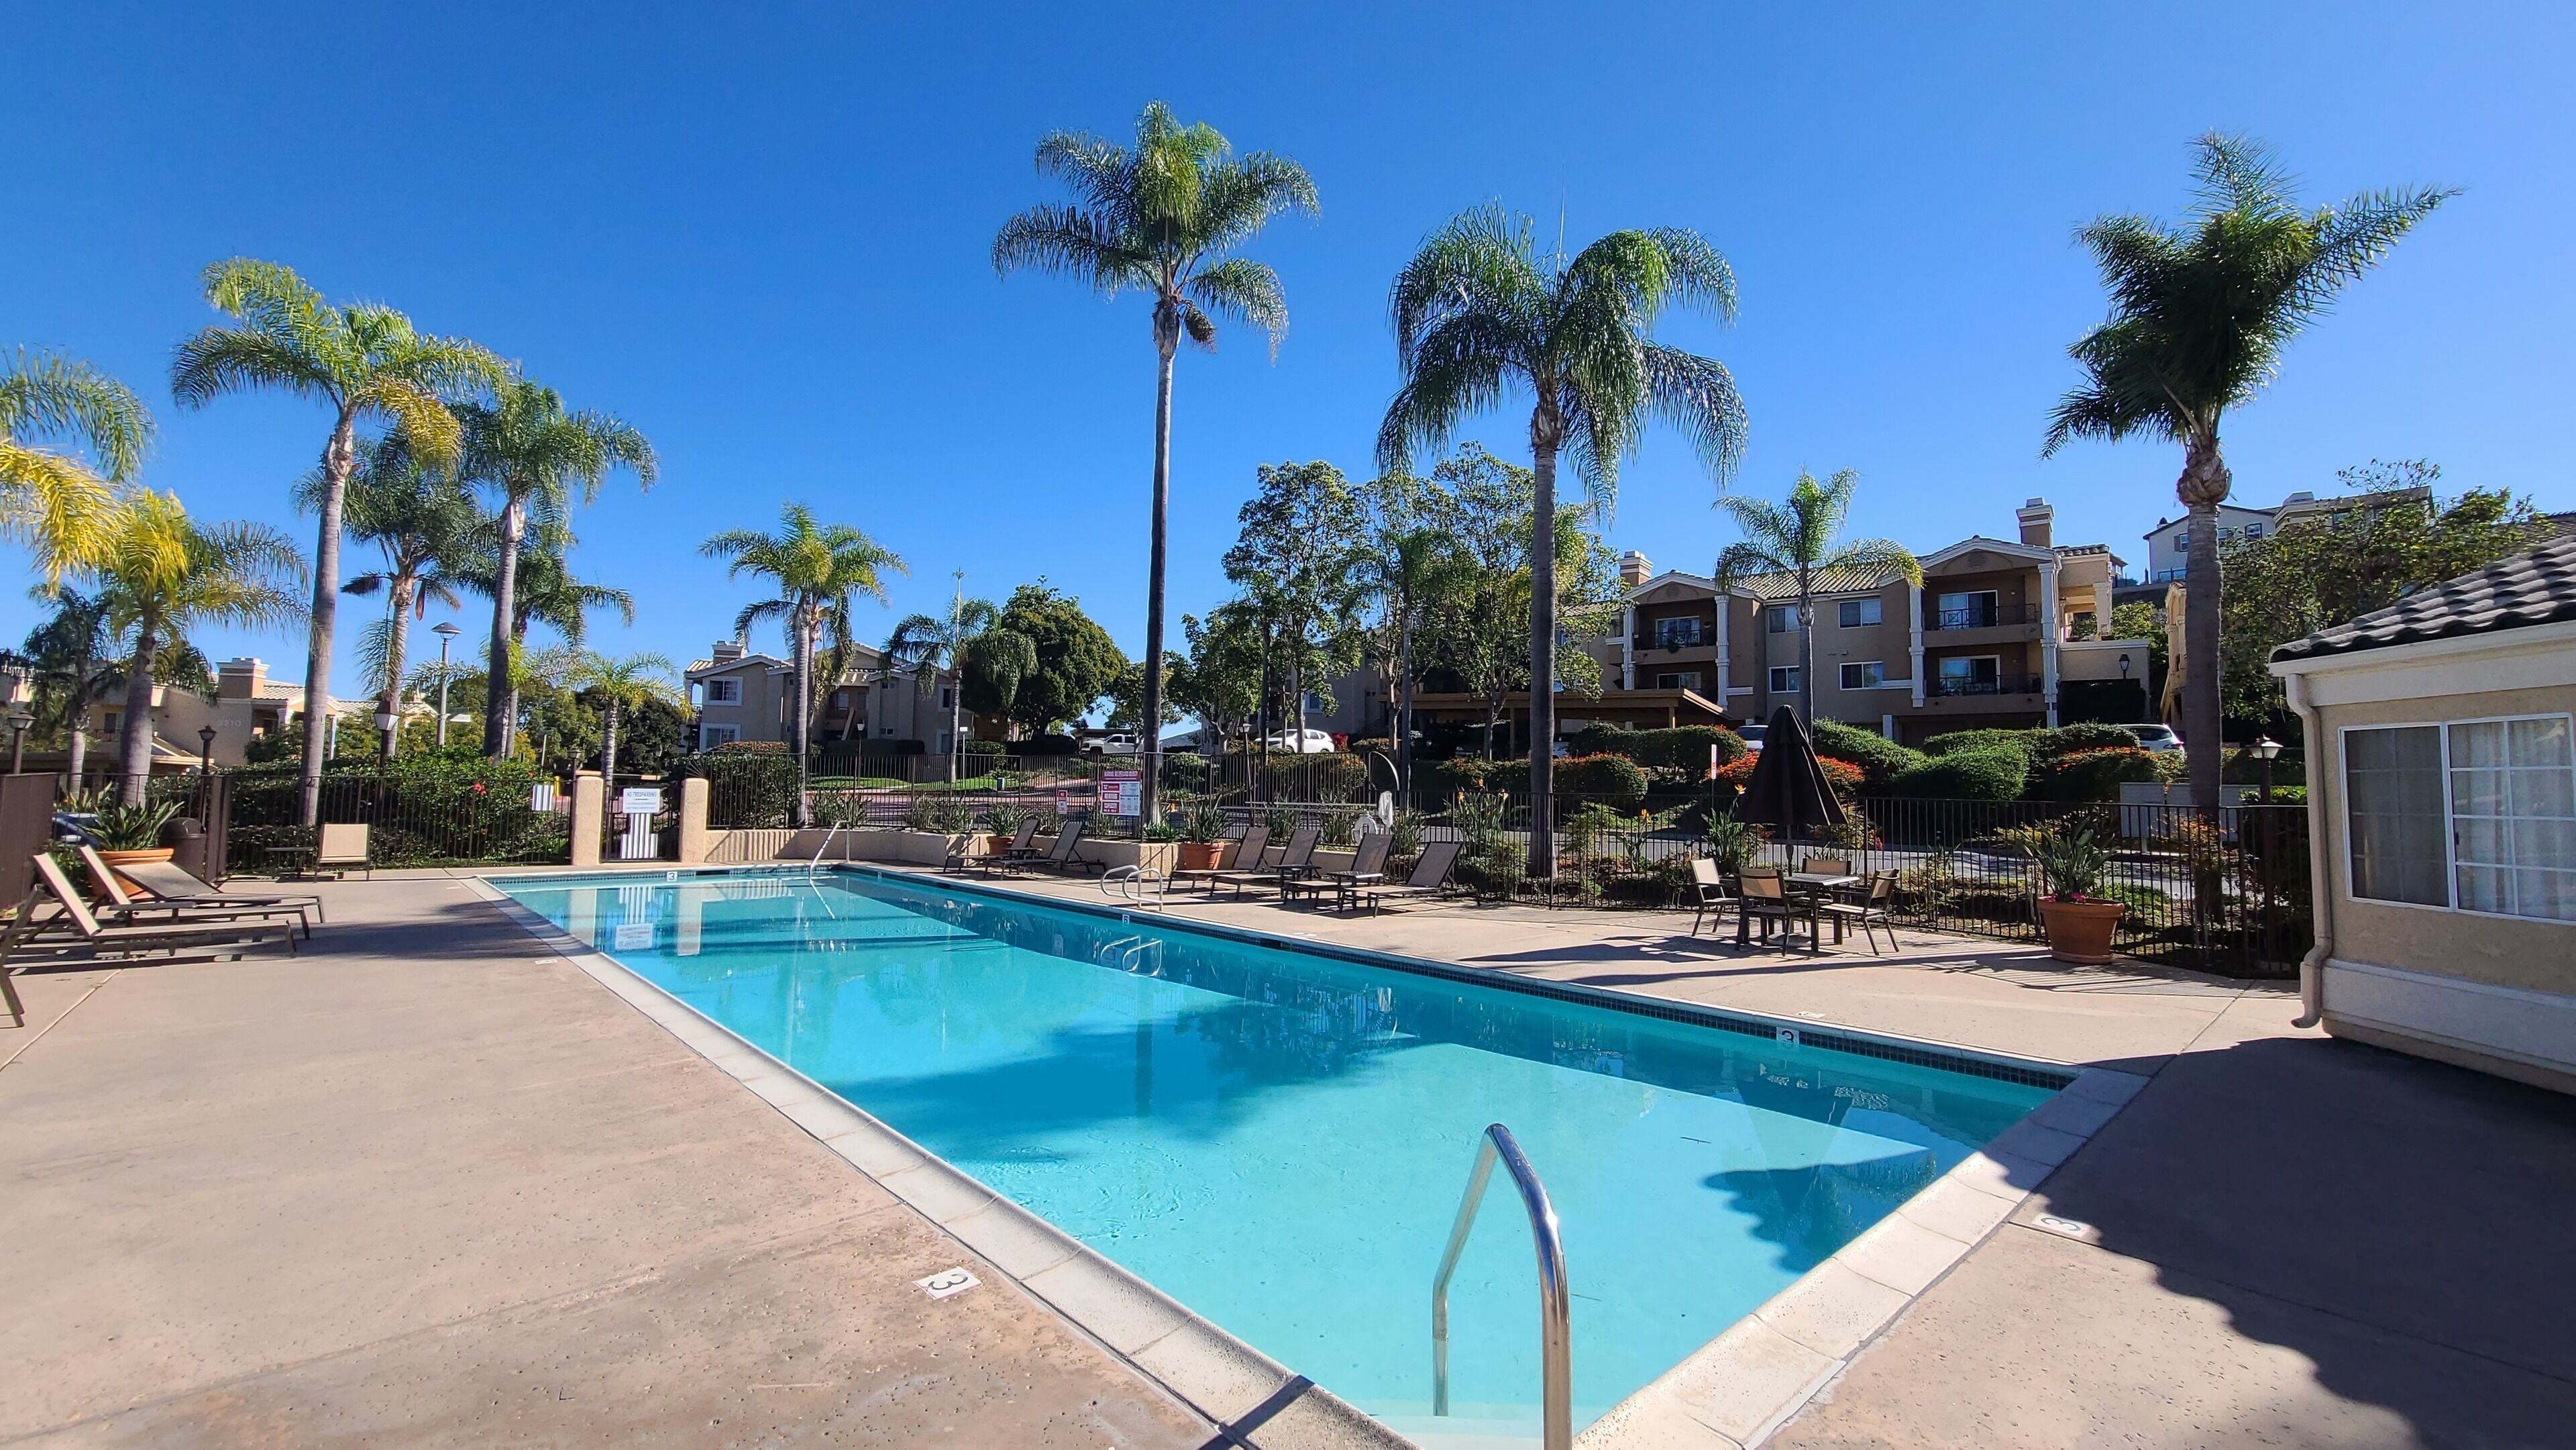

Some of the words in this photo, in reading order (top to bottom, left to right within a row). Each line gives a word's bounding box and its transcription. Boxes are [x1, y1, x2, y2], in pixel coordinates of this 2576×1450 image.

[668, 872, 675, 880] 3
[2040, 1217, 2082, 1232] 3
[928, 1274, 969, 1290] 3
